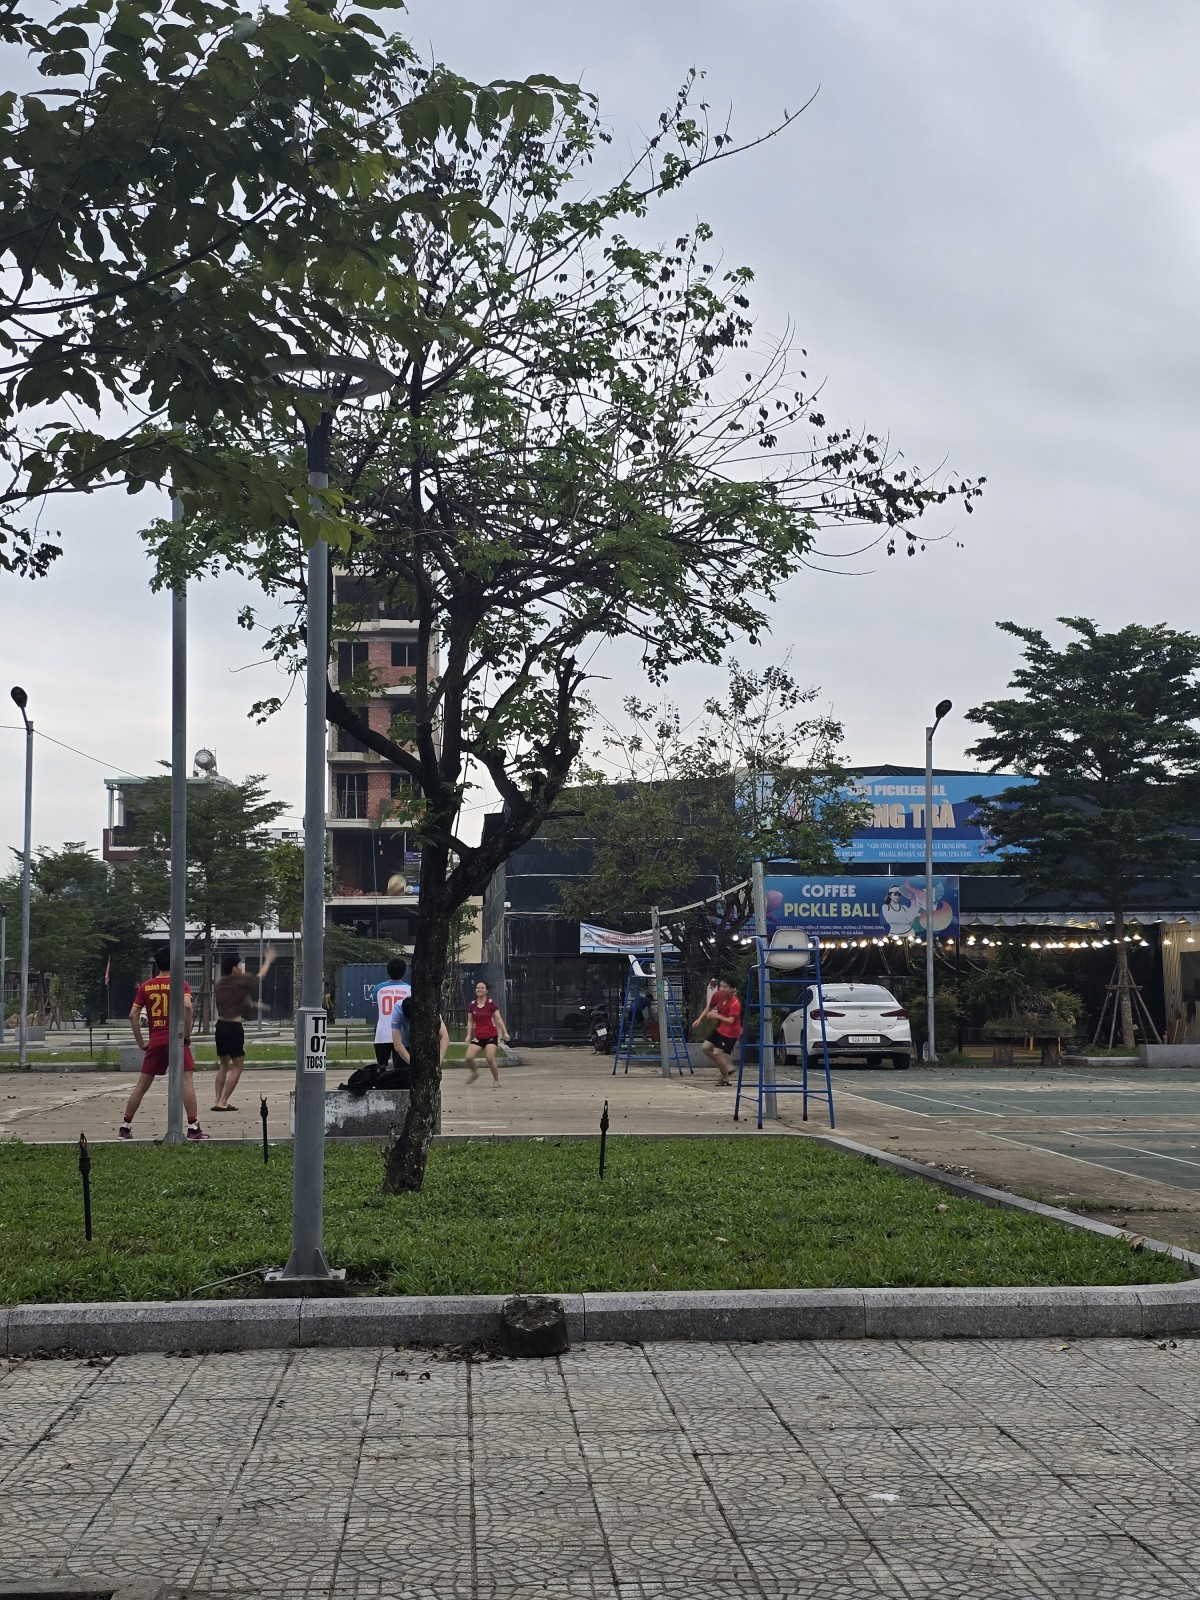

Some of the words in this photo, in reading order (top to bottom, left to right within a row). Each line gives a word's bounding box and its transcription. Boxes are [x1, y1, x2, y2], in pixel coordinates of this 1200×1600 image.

[802, 884, 857, 898] COFFEE
[784, 902, 838, 917] PICKLE
[841, 902, 879, 917] BALL
[150, 993, 168, 1016] 21
[311, 1035, 326, 1053] 07
